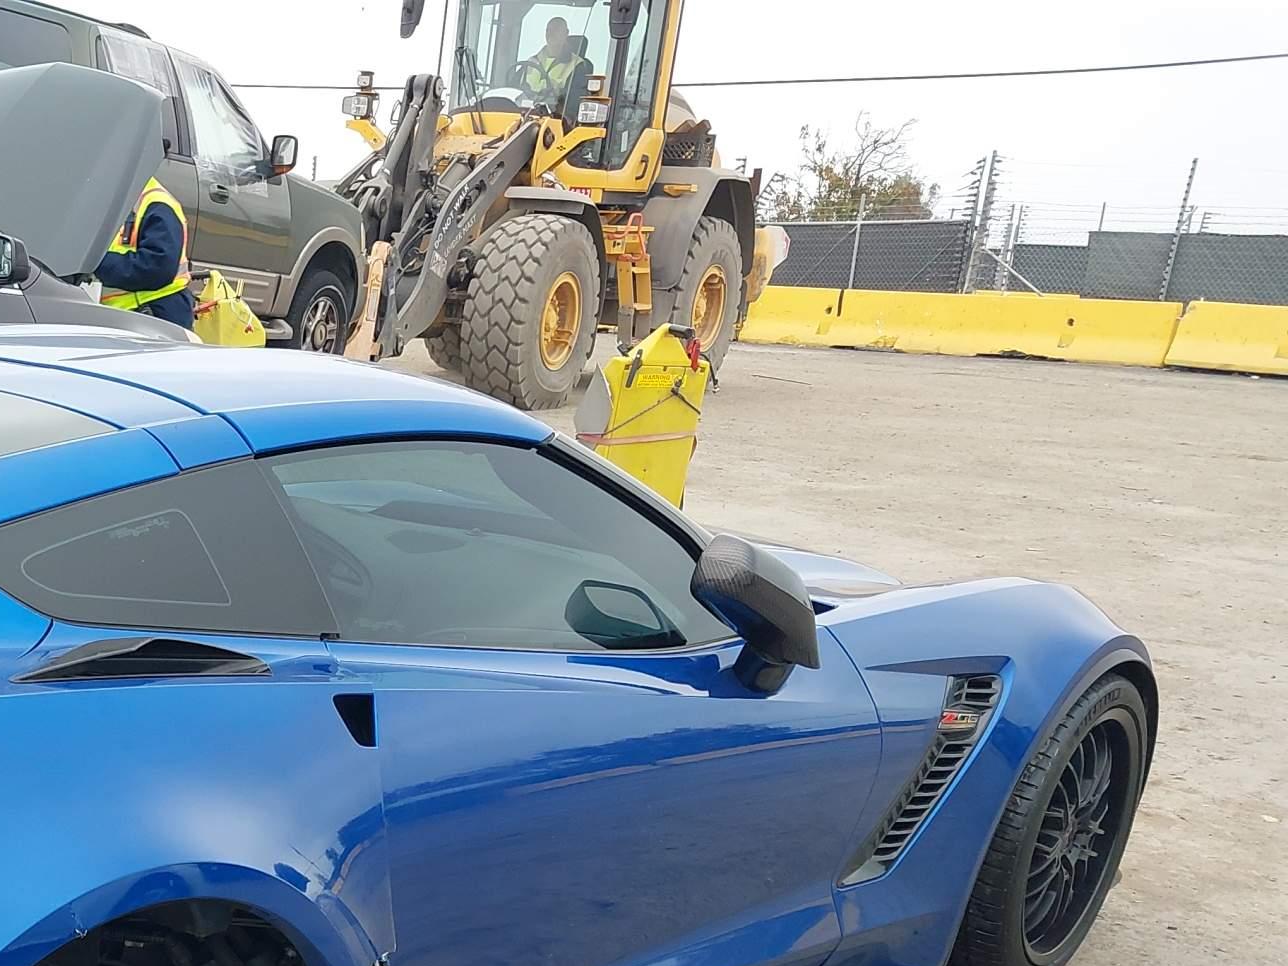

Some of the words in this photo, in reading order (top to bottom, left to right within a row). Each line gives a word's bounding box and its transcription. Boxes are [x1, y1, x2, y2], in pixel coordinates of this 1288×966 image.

[434, 233, 443, 249] DO
[442, 210, 454, 234] NOT
[453, 184, 470, 211] WALK
